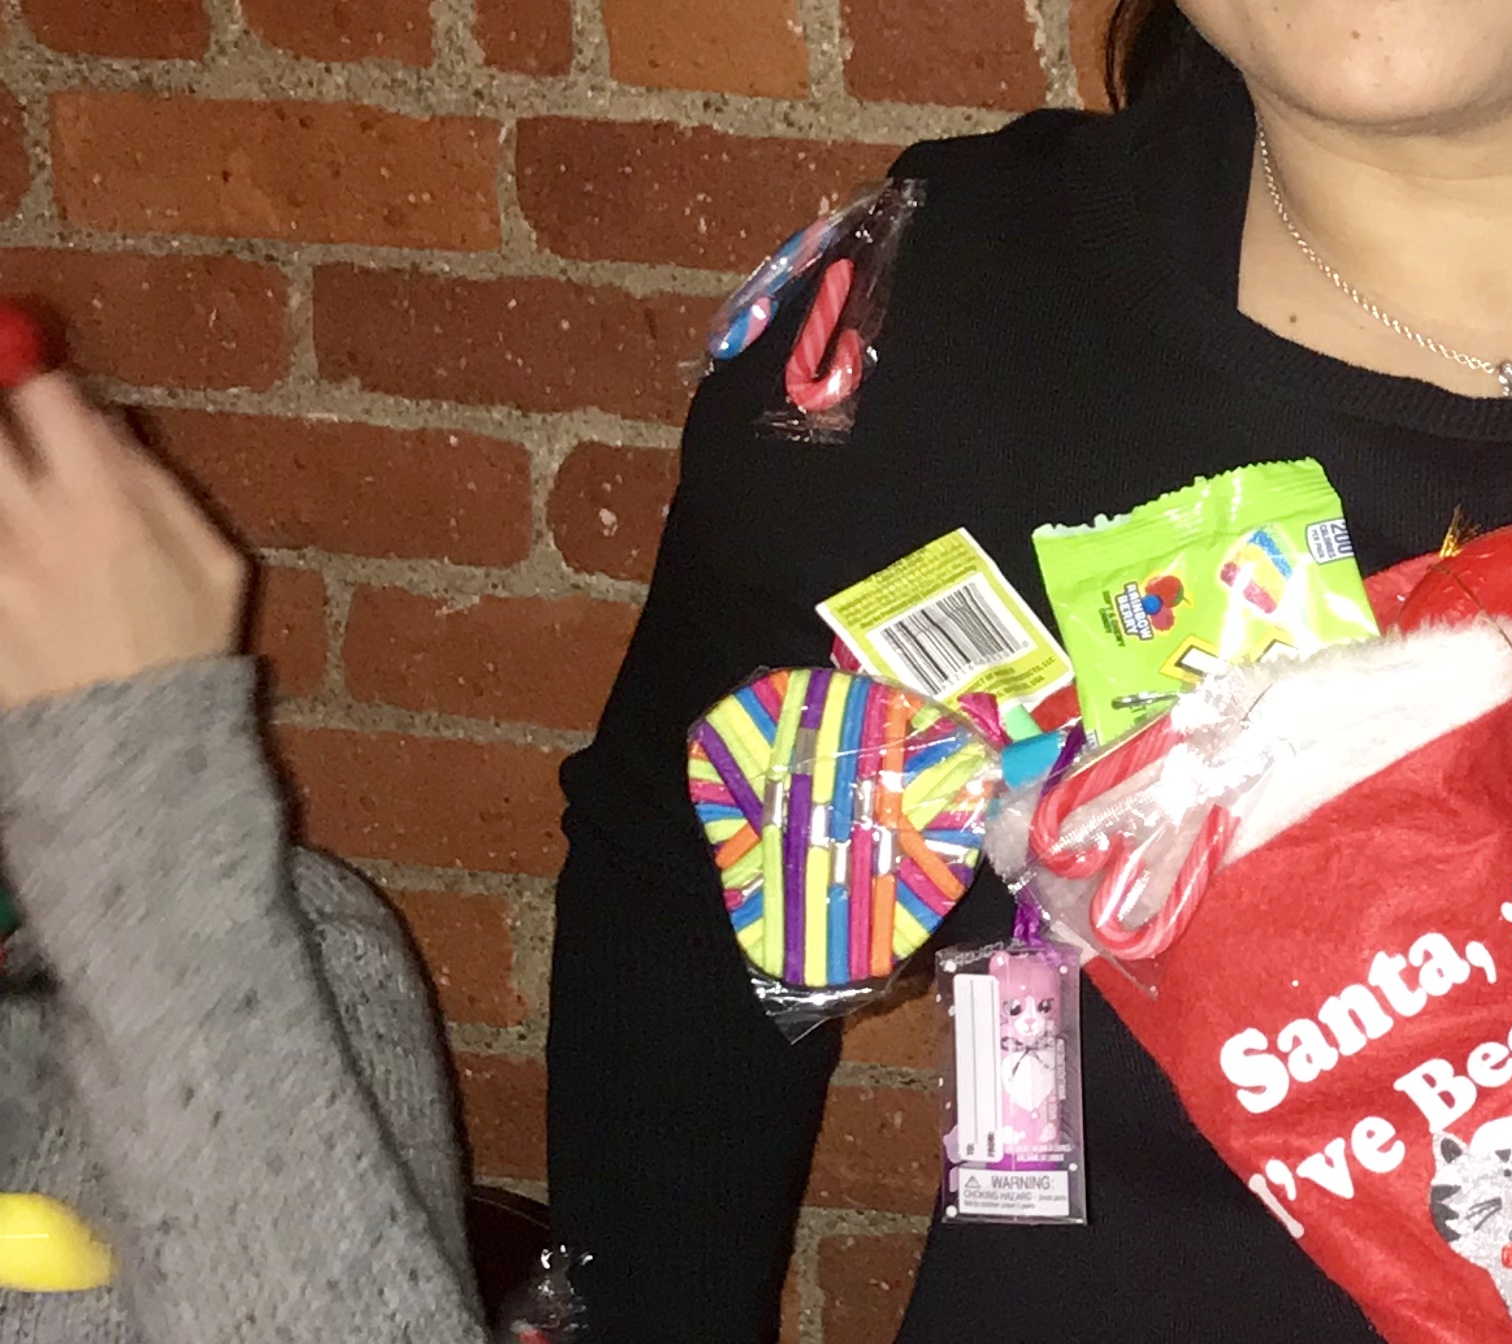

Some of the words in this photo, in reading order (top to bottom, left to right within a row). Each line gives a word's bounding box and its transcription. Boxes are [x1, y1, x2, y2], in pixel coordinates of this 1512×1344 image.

[1319, 523, 1336, 559] CALORIES
[1116, 593, 1137, 635] BERRY
[1126, 582, 1151, 640] RAINBOW
[1221, 932, 1497, 1114] Santa,
[1250, 1112, 1406, 1238] I've
